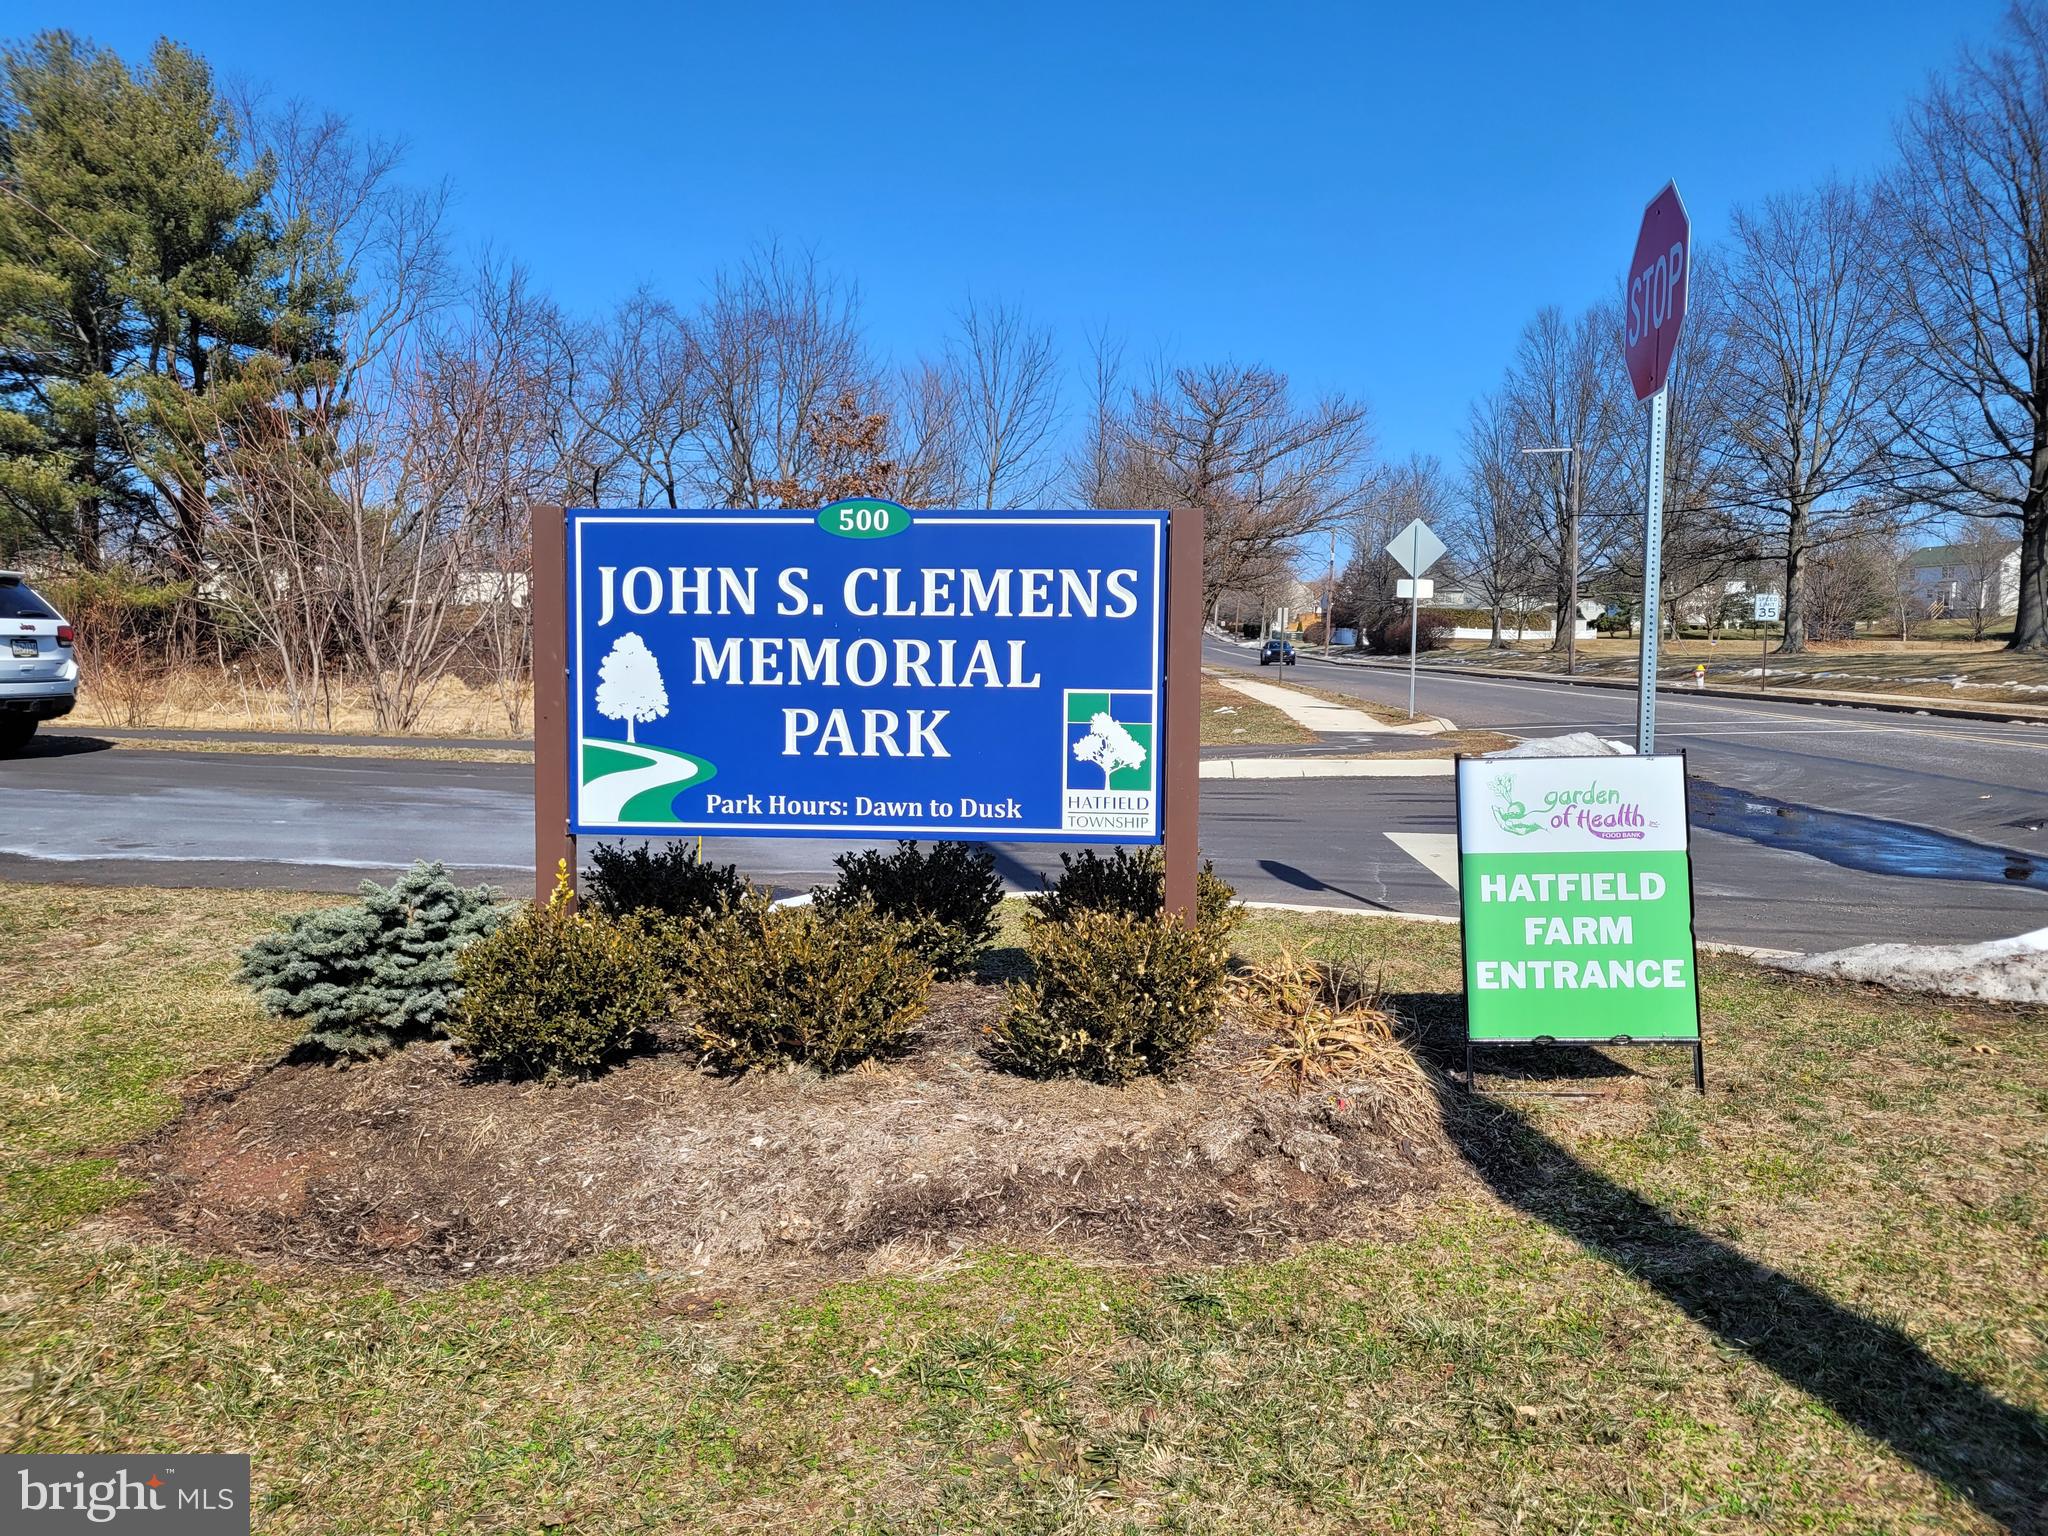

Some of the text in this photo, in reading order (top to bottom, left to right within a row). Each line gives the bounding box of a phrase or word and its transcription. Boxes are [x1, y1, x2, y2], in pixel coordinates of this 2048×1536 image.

[1629, 241, 1683, 348] STOP
[838, 509, 889, 531] 500
[598, 566, 1138, 626] JOHN S. CLEMENS
[1759, 607, 1776, 617] 35
[692, 637, 1041, 688] MEMORIAL
[782, 708, 951, 758] PARK
[706, 794, 1022, 818] Park Hours: Dawn to Dusk
[1068, 796, 1149, 810] HATFIELD
[1544, 780, 1620, 808] garden
[1068, 816, 1148, 828] TOWNSHIP
[1551, 804, 1645, 829] of Health
[1602, 831, 1621, 839] FOOD
[1480, 872, 1667, 902] HATFIELD
[1524, 916, 1633, 945] FARM
[1476, 959, 1686, 989] ENTRANCE
